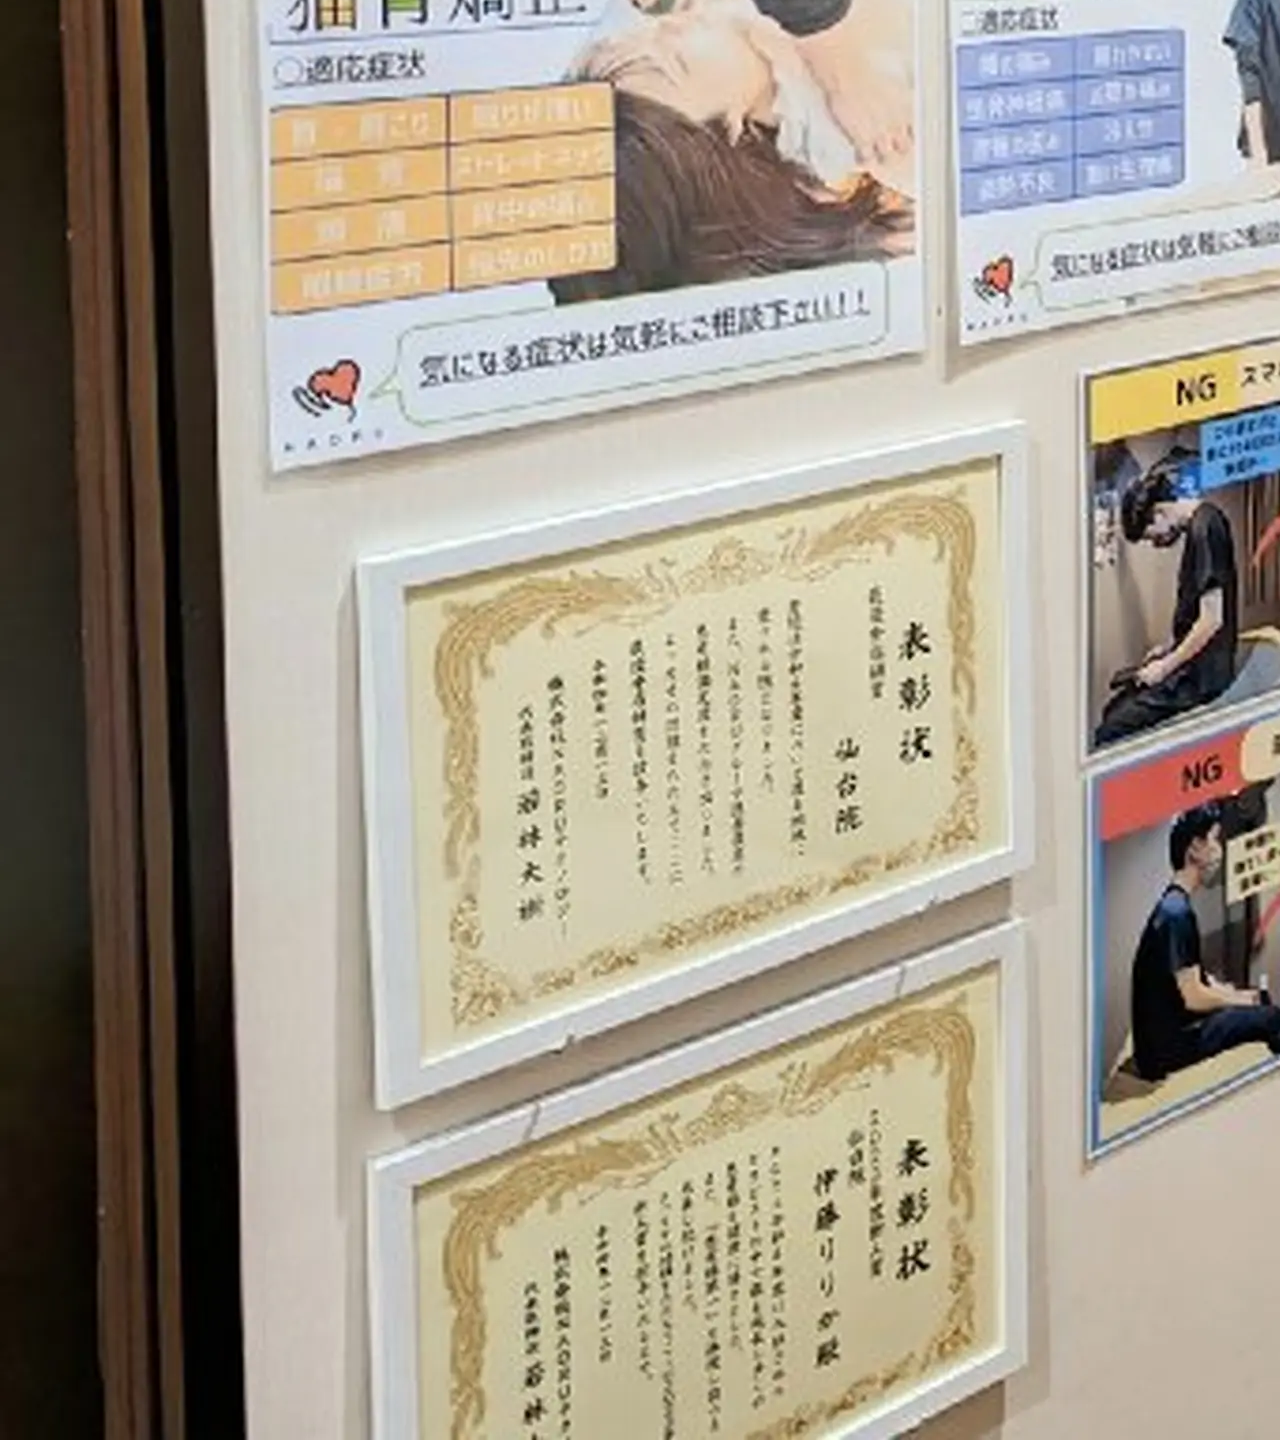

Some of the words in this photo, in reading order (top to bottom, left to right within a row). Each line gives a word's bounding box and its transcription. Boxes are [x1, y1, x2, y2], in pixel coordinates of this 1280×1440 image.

[1175, 378, 1217, 407] NG
[897, 620, 934, 765] 表彰状
[834, 736, 864, 834] 仙台院
[1181, 755, 1223, 791] NG
[895, 1138, 931, 1281] 表彰状
